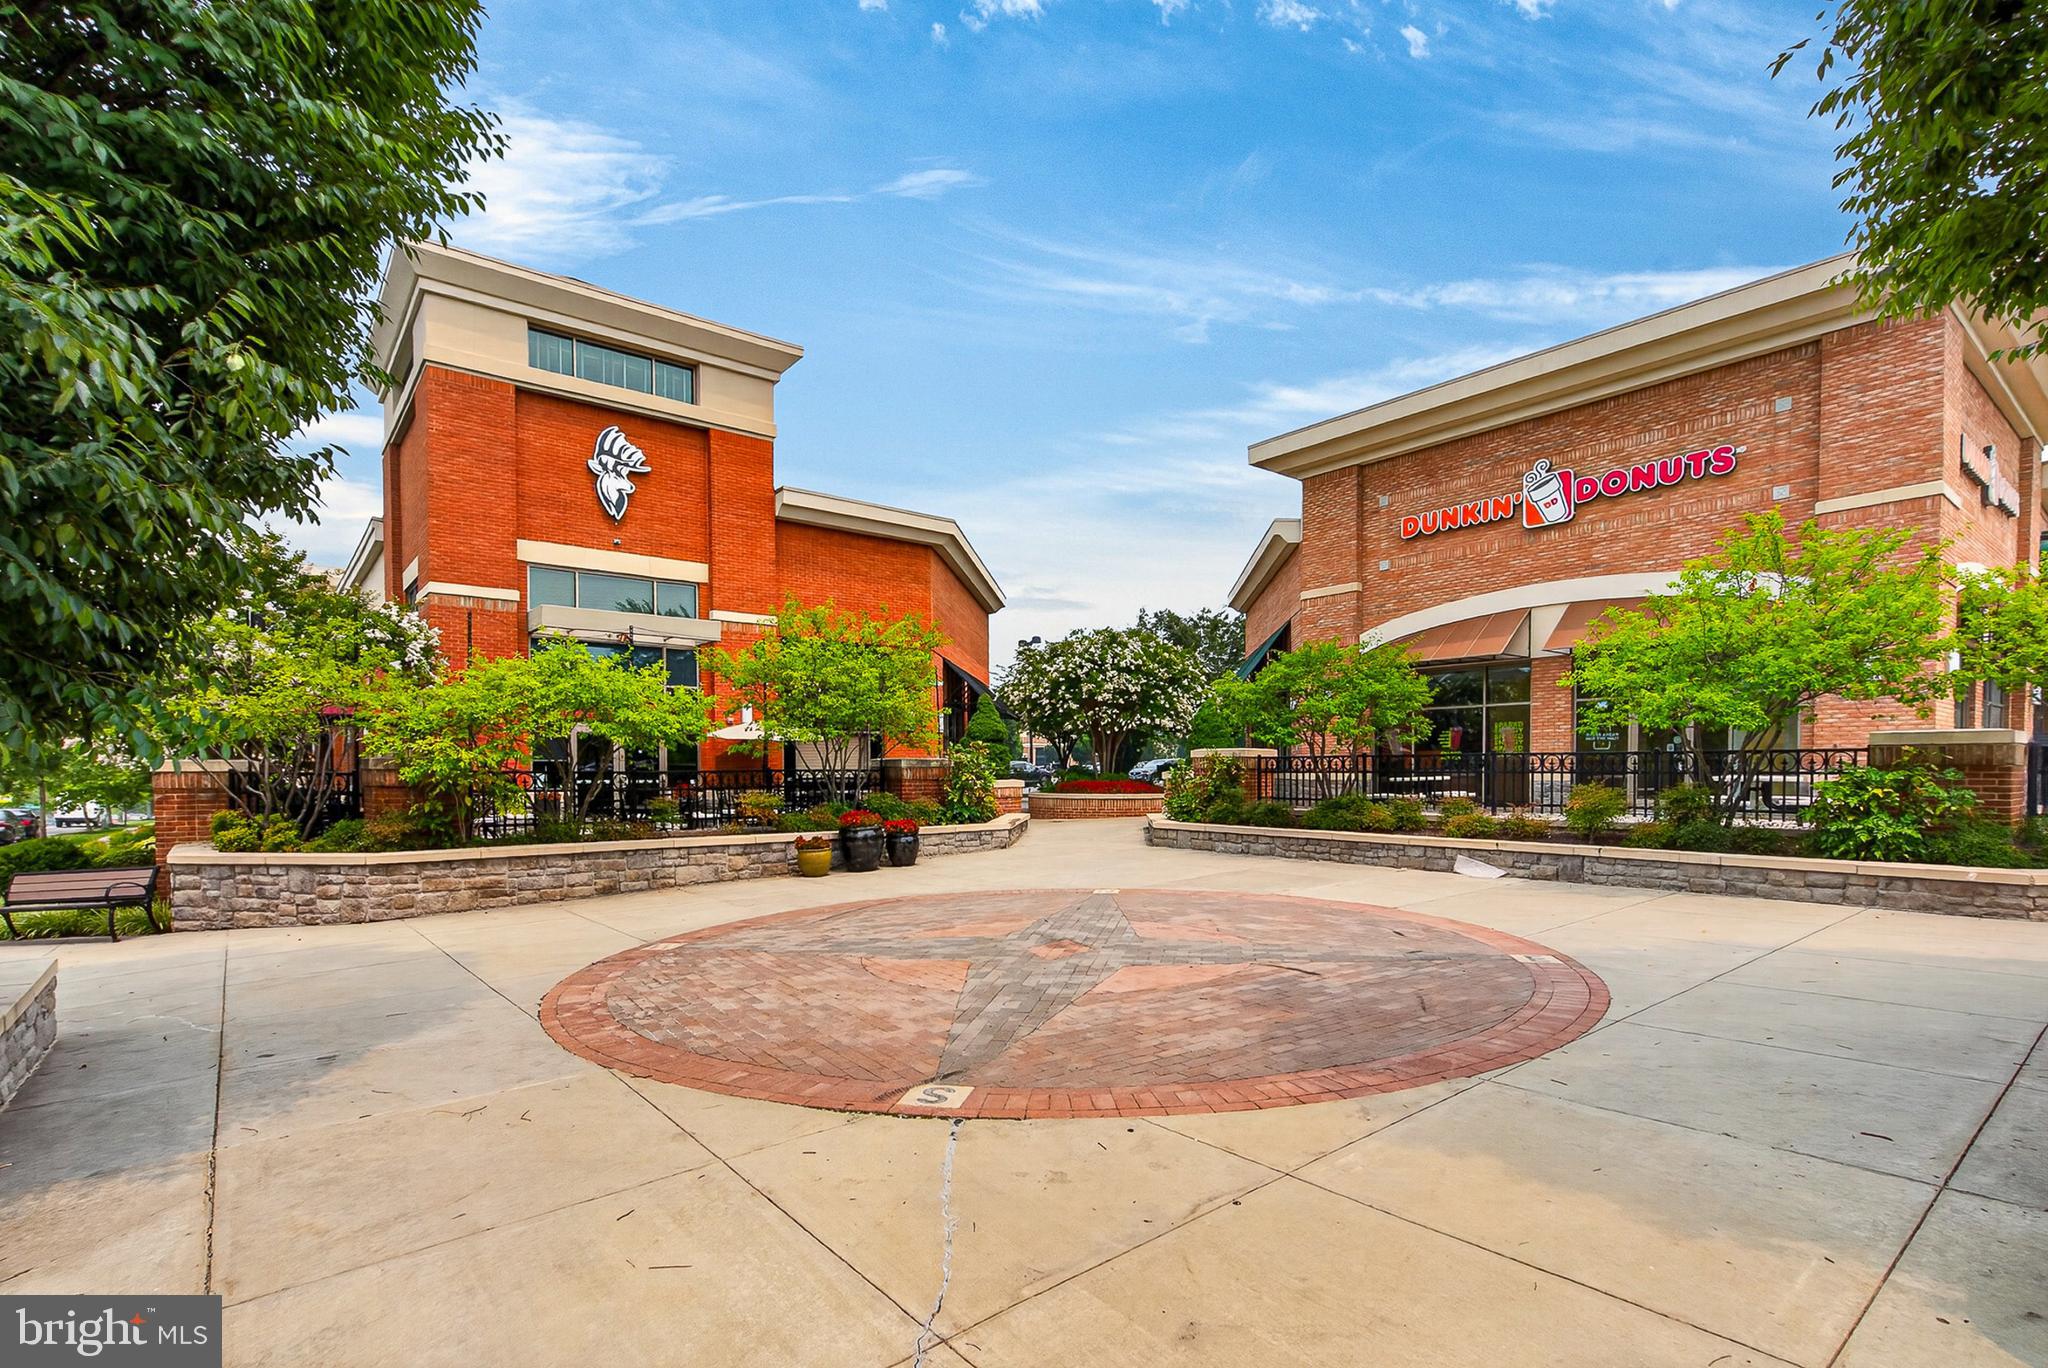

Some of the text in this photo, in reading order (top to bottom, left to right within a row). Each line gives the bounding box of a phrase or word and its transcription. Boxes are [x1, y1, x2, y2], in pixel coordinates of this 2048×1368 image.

[1401, 445, 1736, 539] DUNKIN' DONUTS
[1543, 497, 1558, 509] DD
[916, 1086, 956, 1104] S
